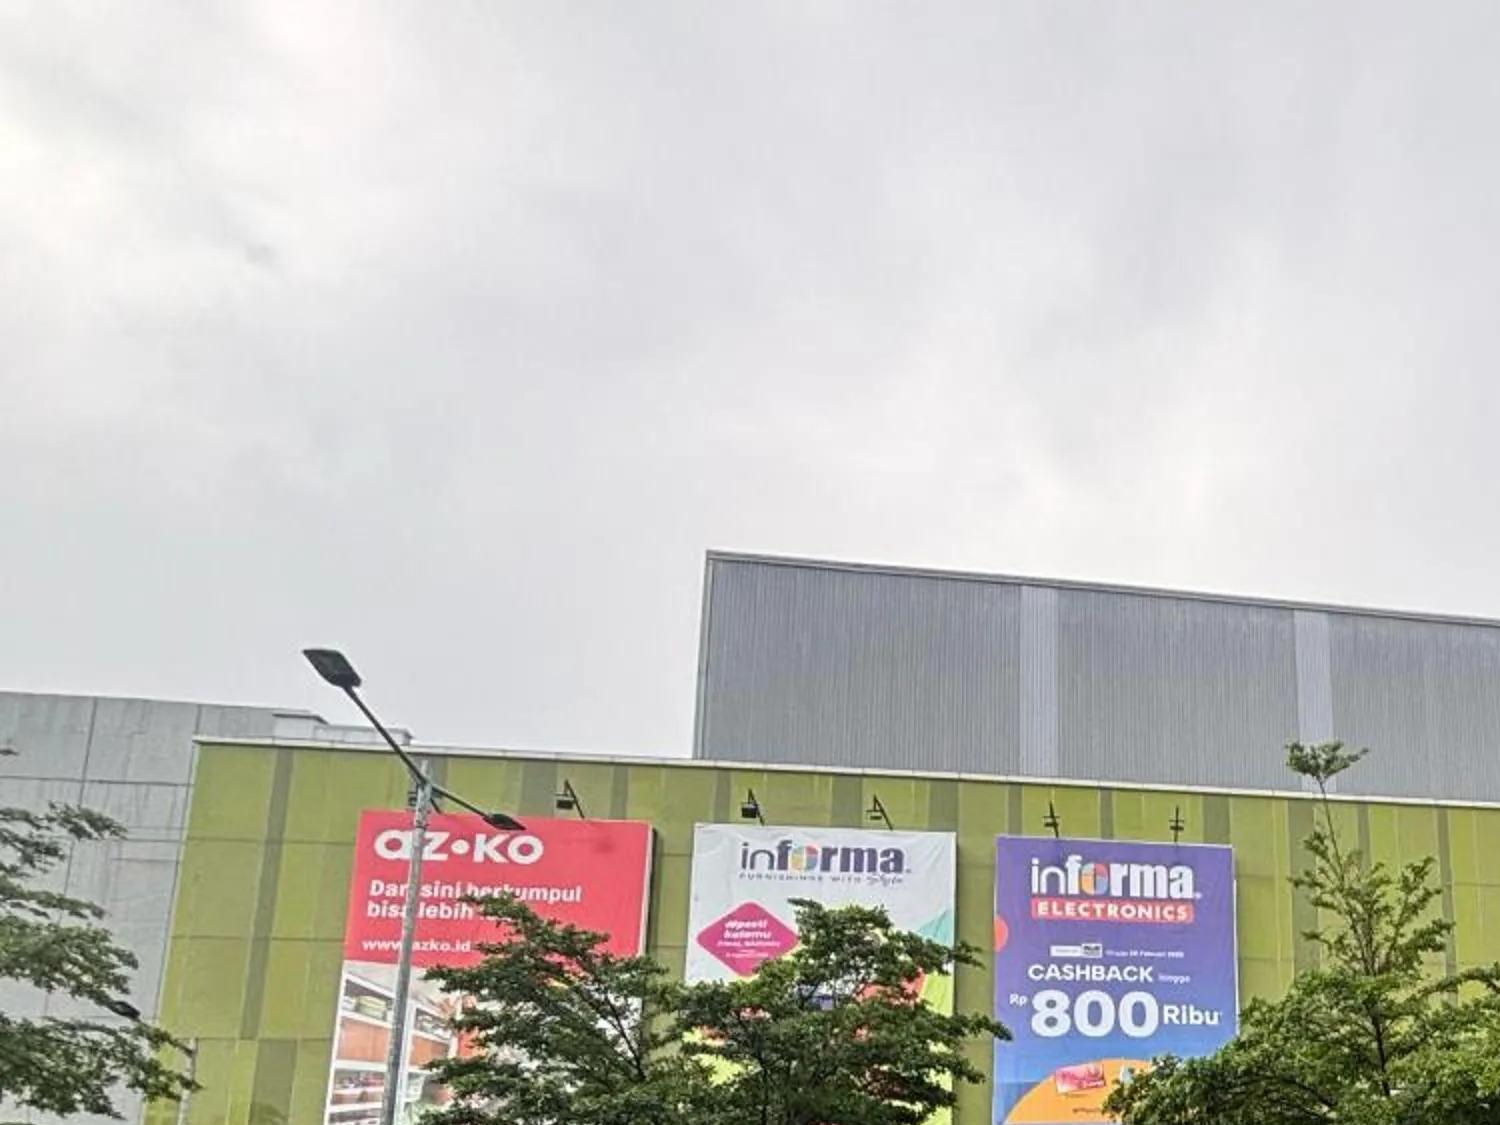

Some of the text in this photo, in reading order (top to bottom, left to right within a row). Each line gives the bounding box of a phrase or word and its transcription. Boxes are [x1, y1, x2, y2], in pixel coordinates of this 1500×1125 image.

[741, 839, 905, 874] informa
[1031, 855, 1194, 899] informa
[369, 879, 415, 897] Dar
[419, 901, 474, 920] lebih
[1037, 901, 1189, 921] ELECTRONICS
[1027, 964, 1154, 983] CASHBACK
[1009, 993, 1028, 1007] Rp
[1031, 989, 1159, 1038] 800
